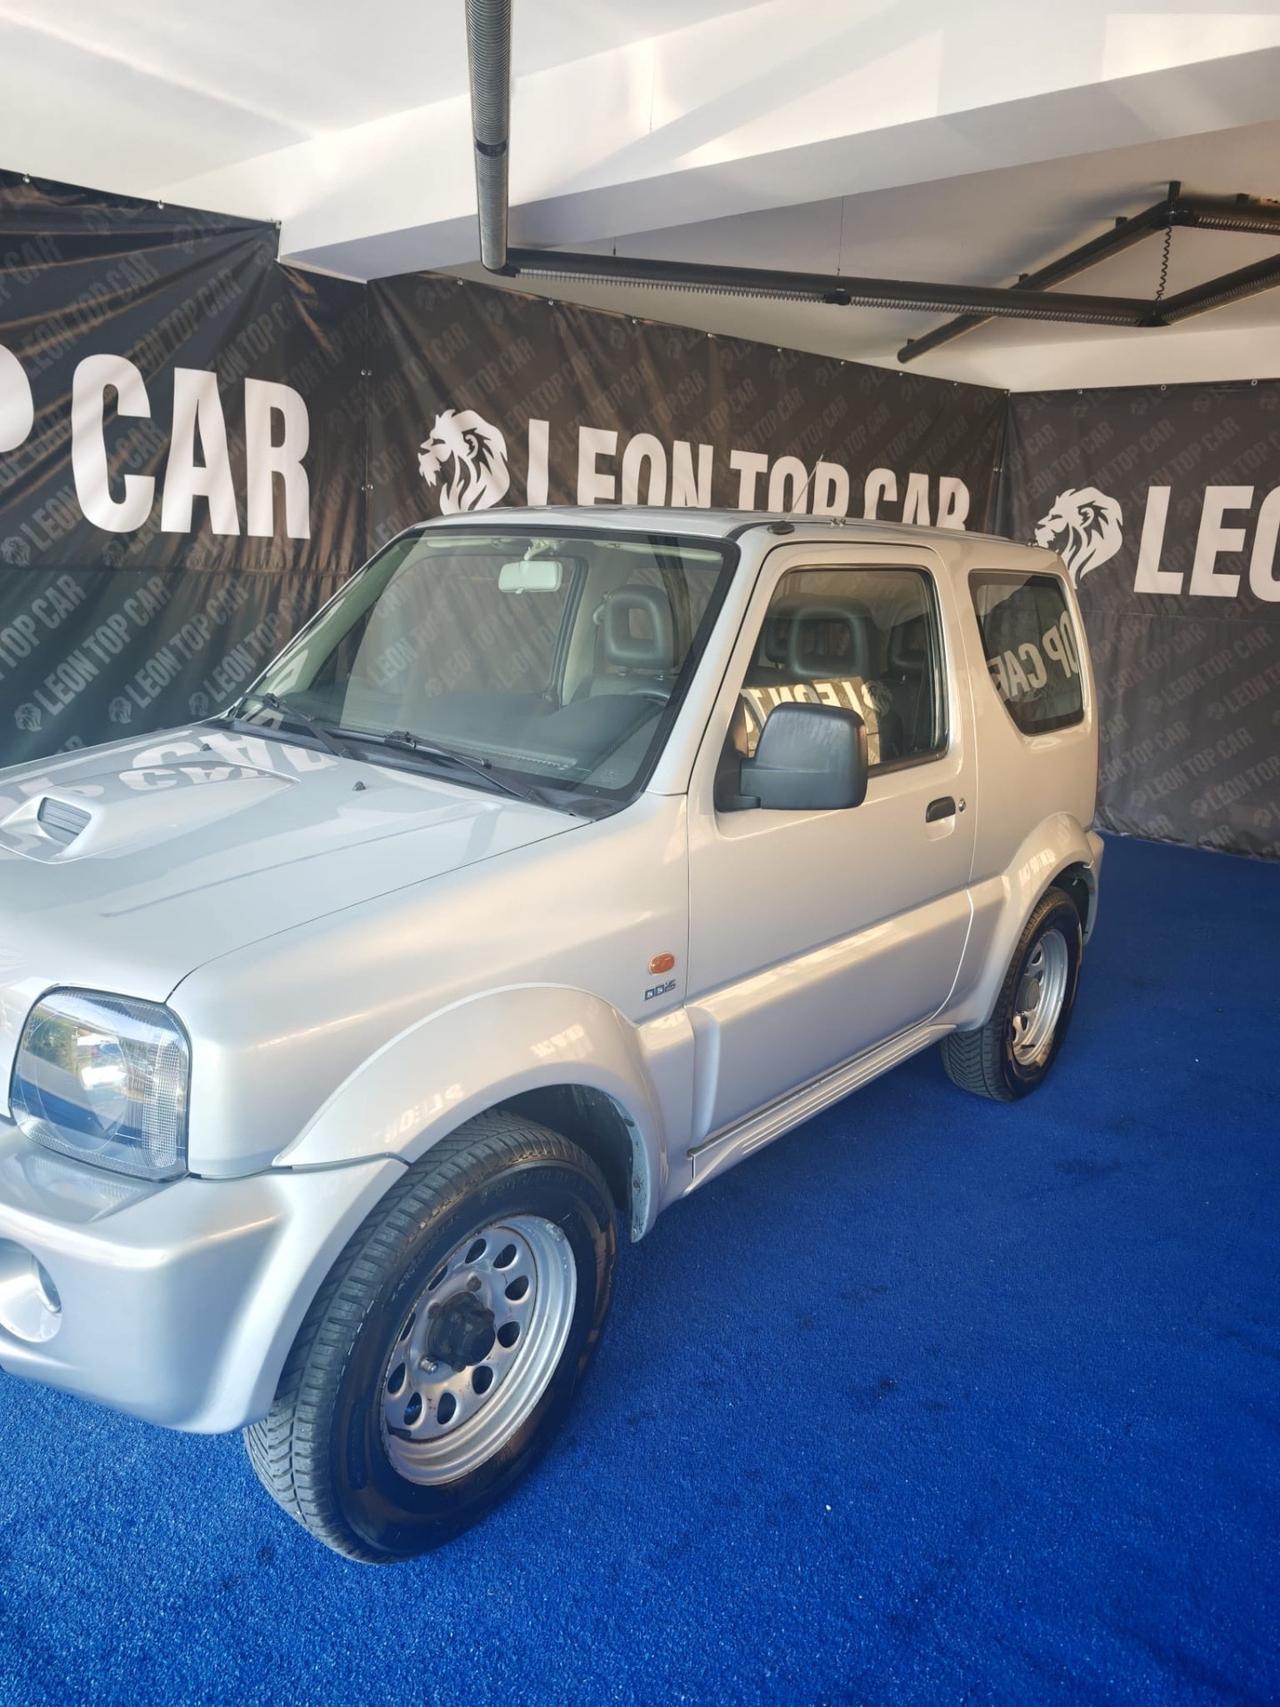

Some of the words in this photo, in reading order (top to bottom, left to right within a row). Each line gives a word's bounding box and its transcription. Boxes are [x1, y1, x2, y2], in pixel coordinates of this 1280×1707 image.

[71, 354, 310, 539] CAR
[527, 418, 714, 508] LEON
[730, 450, 850, 517] TOP
[863, 468, 970, 531] CAR
[0, 614, 40, 669] TOP
[32, 574, 87, 629] CAR
[32, 648, 100, 716] LEON
[82, 613, 131, 664] TOP
[123, 576, 172, 627] CAR
[124, 645, 183, 709] LEON
[169, 613, 211, 660] TOP
[202, 643, 257, 703] LEON
[244, 613, 282, 656] TOP
[1233, 626, 1273, 659] CAR
[1155, 720, 1191, 751] CAR
[1223, 673, 1271, 713] LEON
[1144, 764, 1189, 800] LEON
[1183, 747, 1216, 777] TOP
[1216, 728, 1255, 759] CAR
[1204, 773, 1252, 811] LEON
